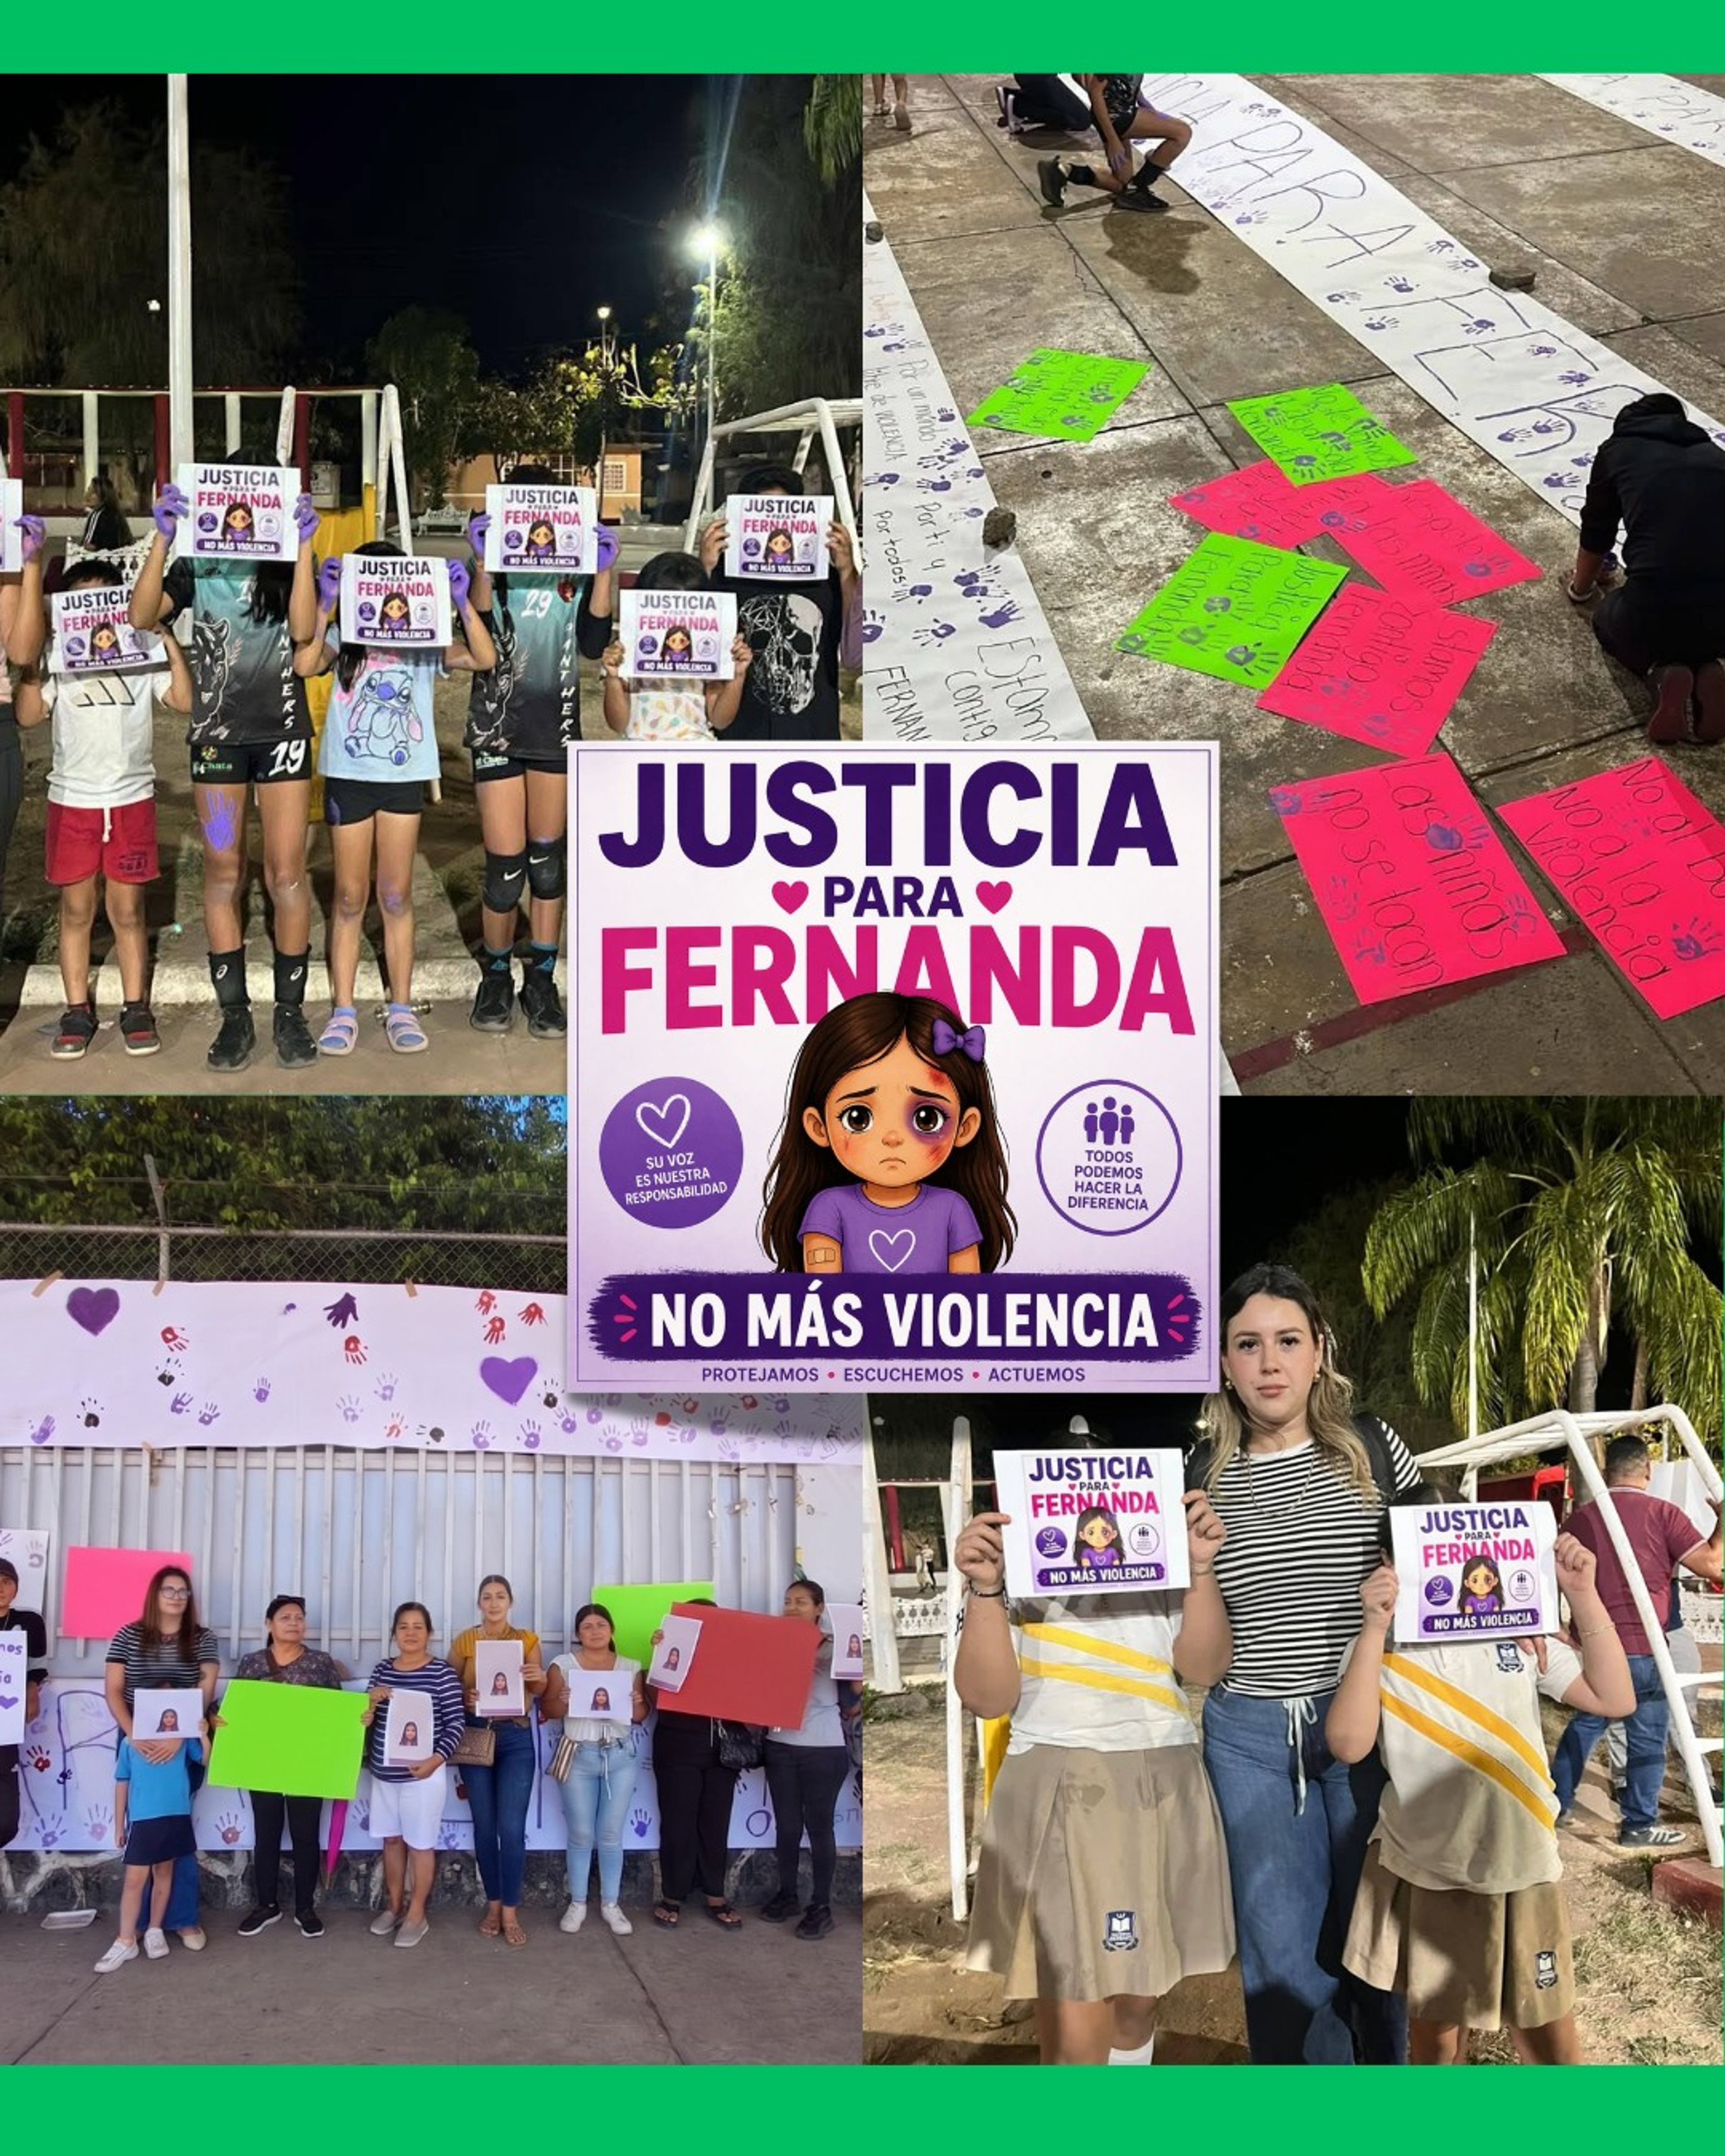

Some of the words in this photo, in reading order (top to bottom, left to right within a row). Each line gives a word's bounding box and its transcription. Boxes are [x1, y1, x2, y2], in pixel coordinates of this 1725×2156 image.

[1192, 120, 1416, 270] PARA
[897, 359, 929, 381] Por
[870, 394, 898, 407] de
[907, 386, 927, 400] un
[198, 469, 279, 486] JUSTICIA
[198, 492, 282, 509] FERNANDA
[506, 490, 578, 504] JUSTICIA
[744, 499, 815, 513] JUSTICIA
[505, 511, 581, 526] FERNANDA
[914, 501, 942, 526] Por
[743, 519, 817, 534] FERNANDA
[924, 530, 950, 547] ti
[358, 561, 431, 575] JUSTICIA
[883, 538, 913, 584] todos
[922, 558, 946, 571] y
[358, 582, 434, 596] FERNANDA
[520, 589, 553, 619] 29
[640, 595, 717, 610] JUSTICIA
[640, 616, 719, 632] FERNANDA
[1281, 592, 1381, 692] Fernanda
[268, 738, 306, 777] 19
[1547, 787, 1603, 827] No
[1616, 760, 1667, 804] No
[1653, 814, 1713, 844] al
[1589, 835, 1632, 860] a
[1341, 840, 1395, 885] se
[1380, 760, 1450, 836] Las
[1426, 849, 1517, 959] niñas
[1607, 861, 1669, 908] la
[1367, 888, 1444, 989] tocan
[1028, 1456, 1154, 1482] JUSTICIA
[1079, 1481, 1110, 1491] PARA
[1031, 1491, 1160, 1518] FERNANDA
[1420, 1507, 1529, 1534] JUSTICIA
[1464, 1531, 1492, 1540] PARA
[1423, 1538, 1535, 1568] FERNANDA
[1049, 1570, 1067, 1584] NO
[1070, 1566, 1097, 1582] MÁS
[1099, 1566, 1158, 1581] VIOLENCIA
[1433, 1617, 1450, 1630] NO
[1453, 1614, 1477, 1629] MÁS
[1480, 1612, 1533, 1628] VIOLENCIA
